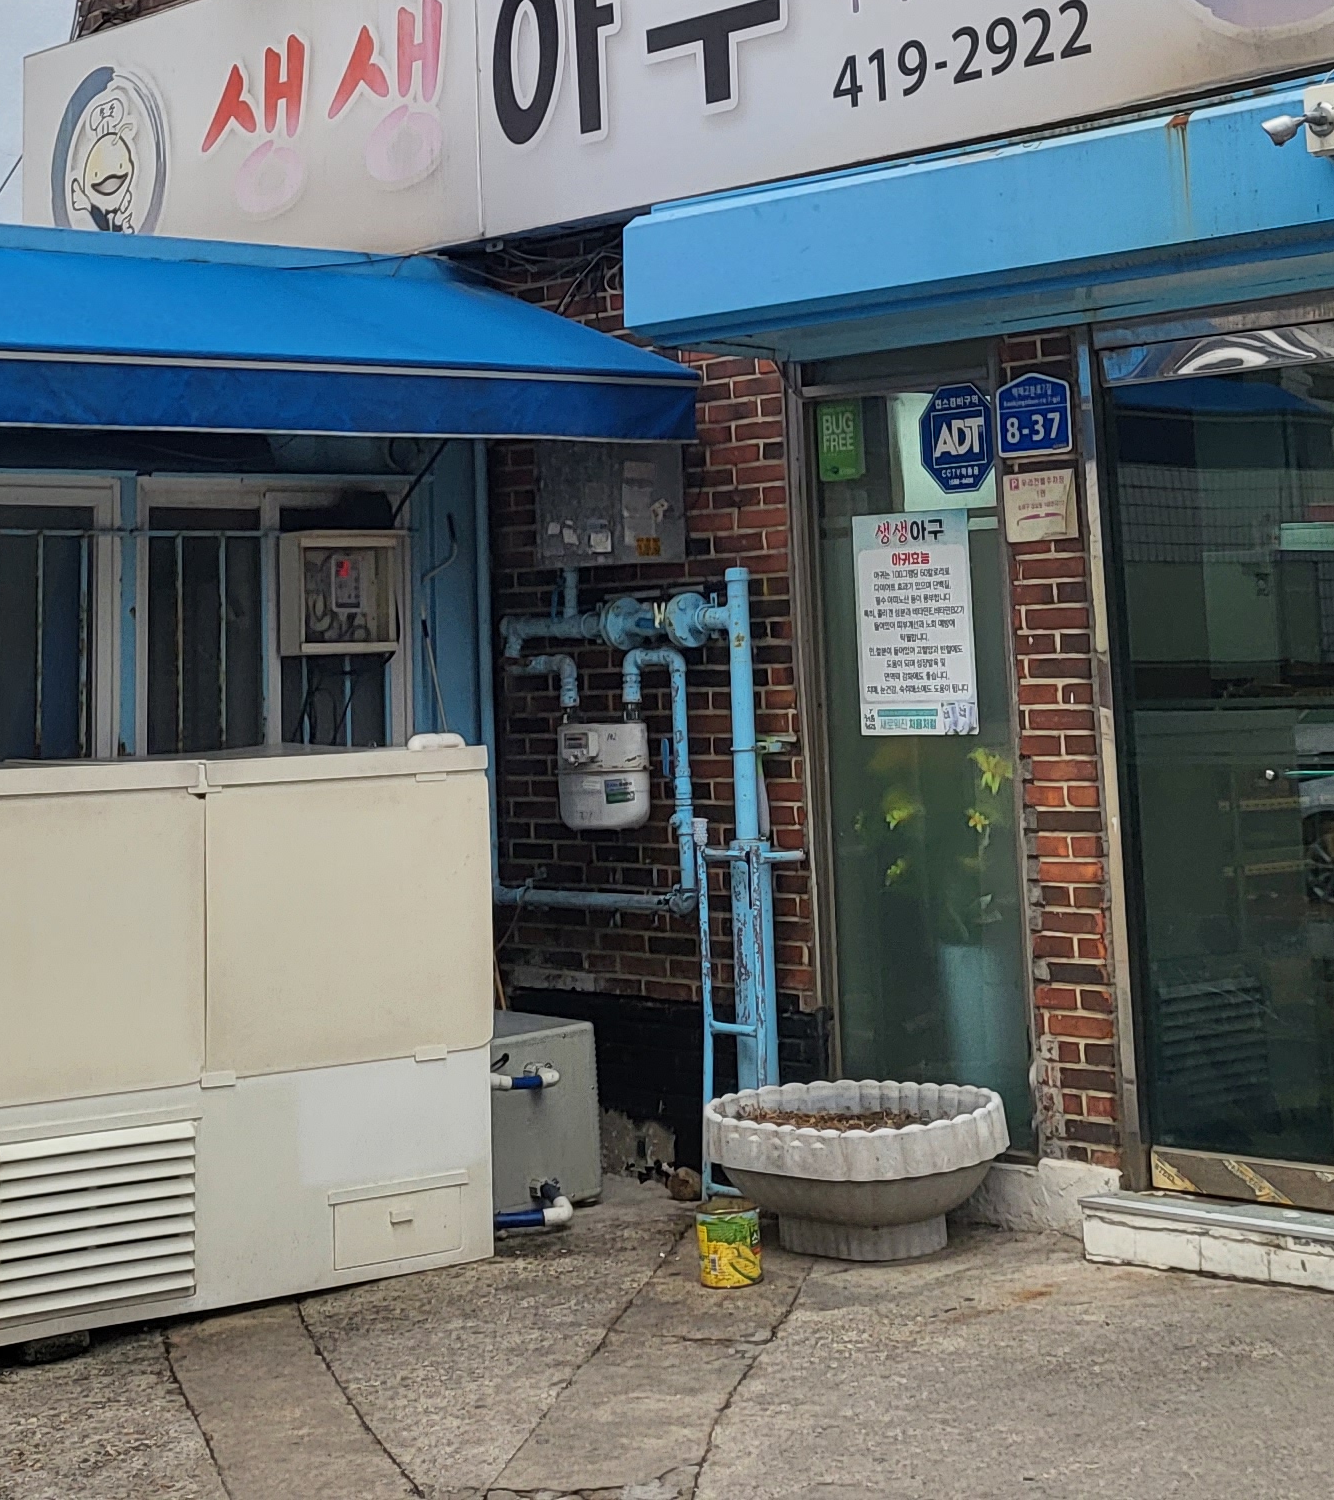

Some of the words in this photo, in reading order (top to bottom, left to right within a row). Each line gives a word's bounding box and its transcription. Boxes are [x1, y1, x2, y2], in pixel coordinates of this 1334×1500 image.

[823, 412, 854, 434] BUG
[1007, 412, 1060, 444] 8-37
[824, 433, 855, 453] FREE
[934, 417, 984, 458] ADT
